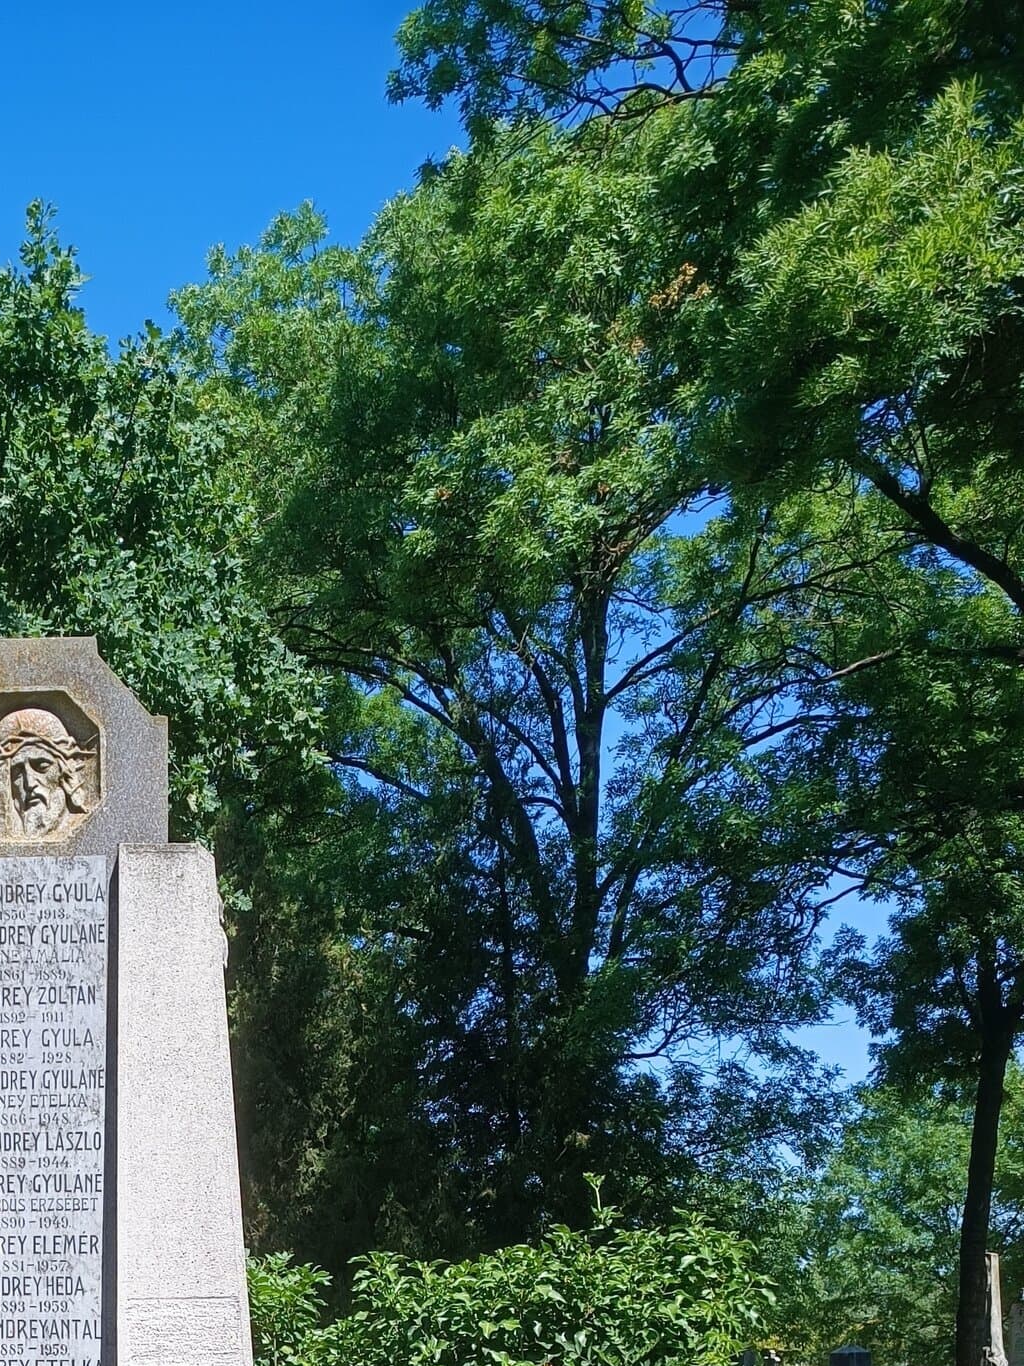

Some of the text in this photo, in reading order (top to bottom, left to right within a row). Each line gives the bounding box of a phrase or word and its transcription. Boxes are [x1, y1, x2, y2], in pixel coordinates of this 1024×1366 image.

[53, 883, 105, 902] GYULA
[38, 979, 97, 1005] ZOLTÁN
[42, 1028, 94, 1047] GYULA
[43, 1065, 105, 1089] GYULÁNÉ
[31, 1094, 88, 1108] ETELKA
[46, 1127, 102, 1151] LÁSZLÓ
[32, 1169, 102, 1193] GYULÁNÉ
[31, 1195, 98, 1212] ERZSÉBET
[33, 1231, 99, 1255] ELEMÉR
[46, 1276, 85, 1296] HEDA
[48, 1319, 102, 1339] ANTAL
